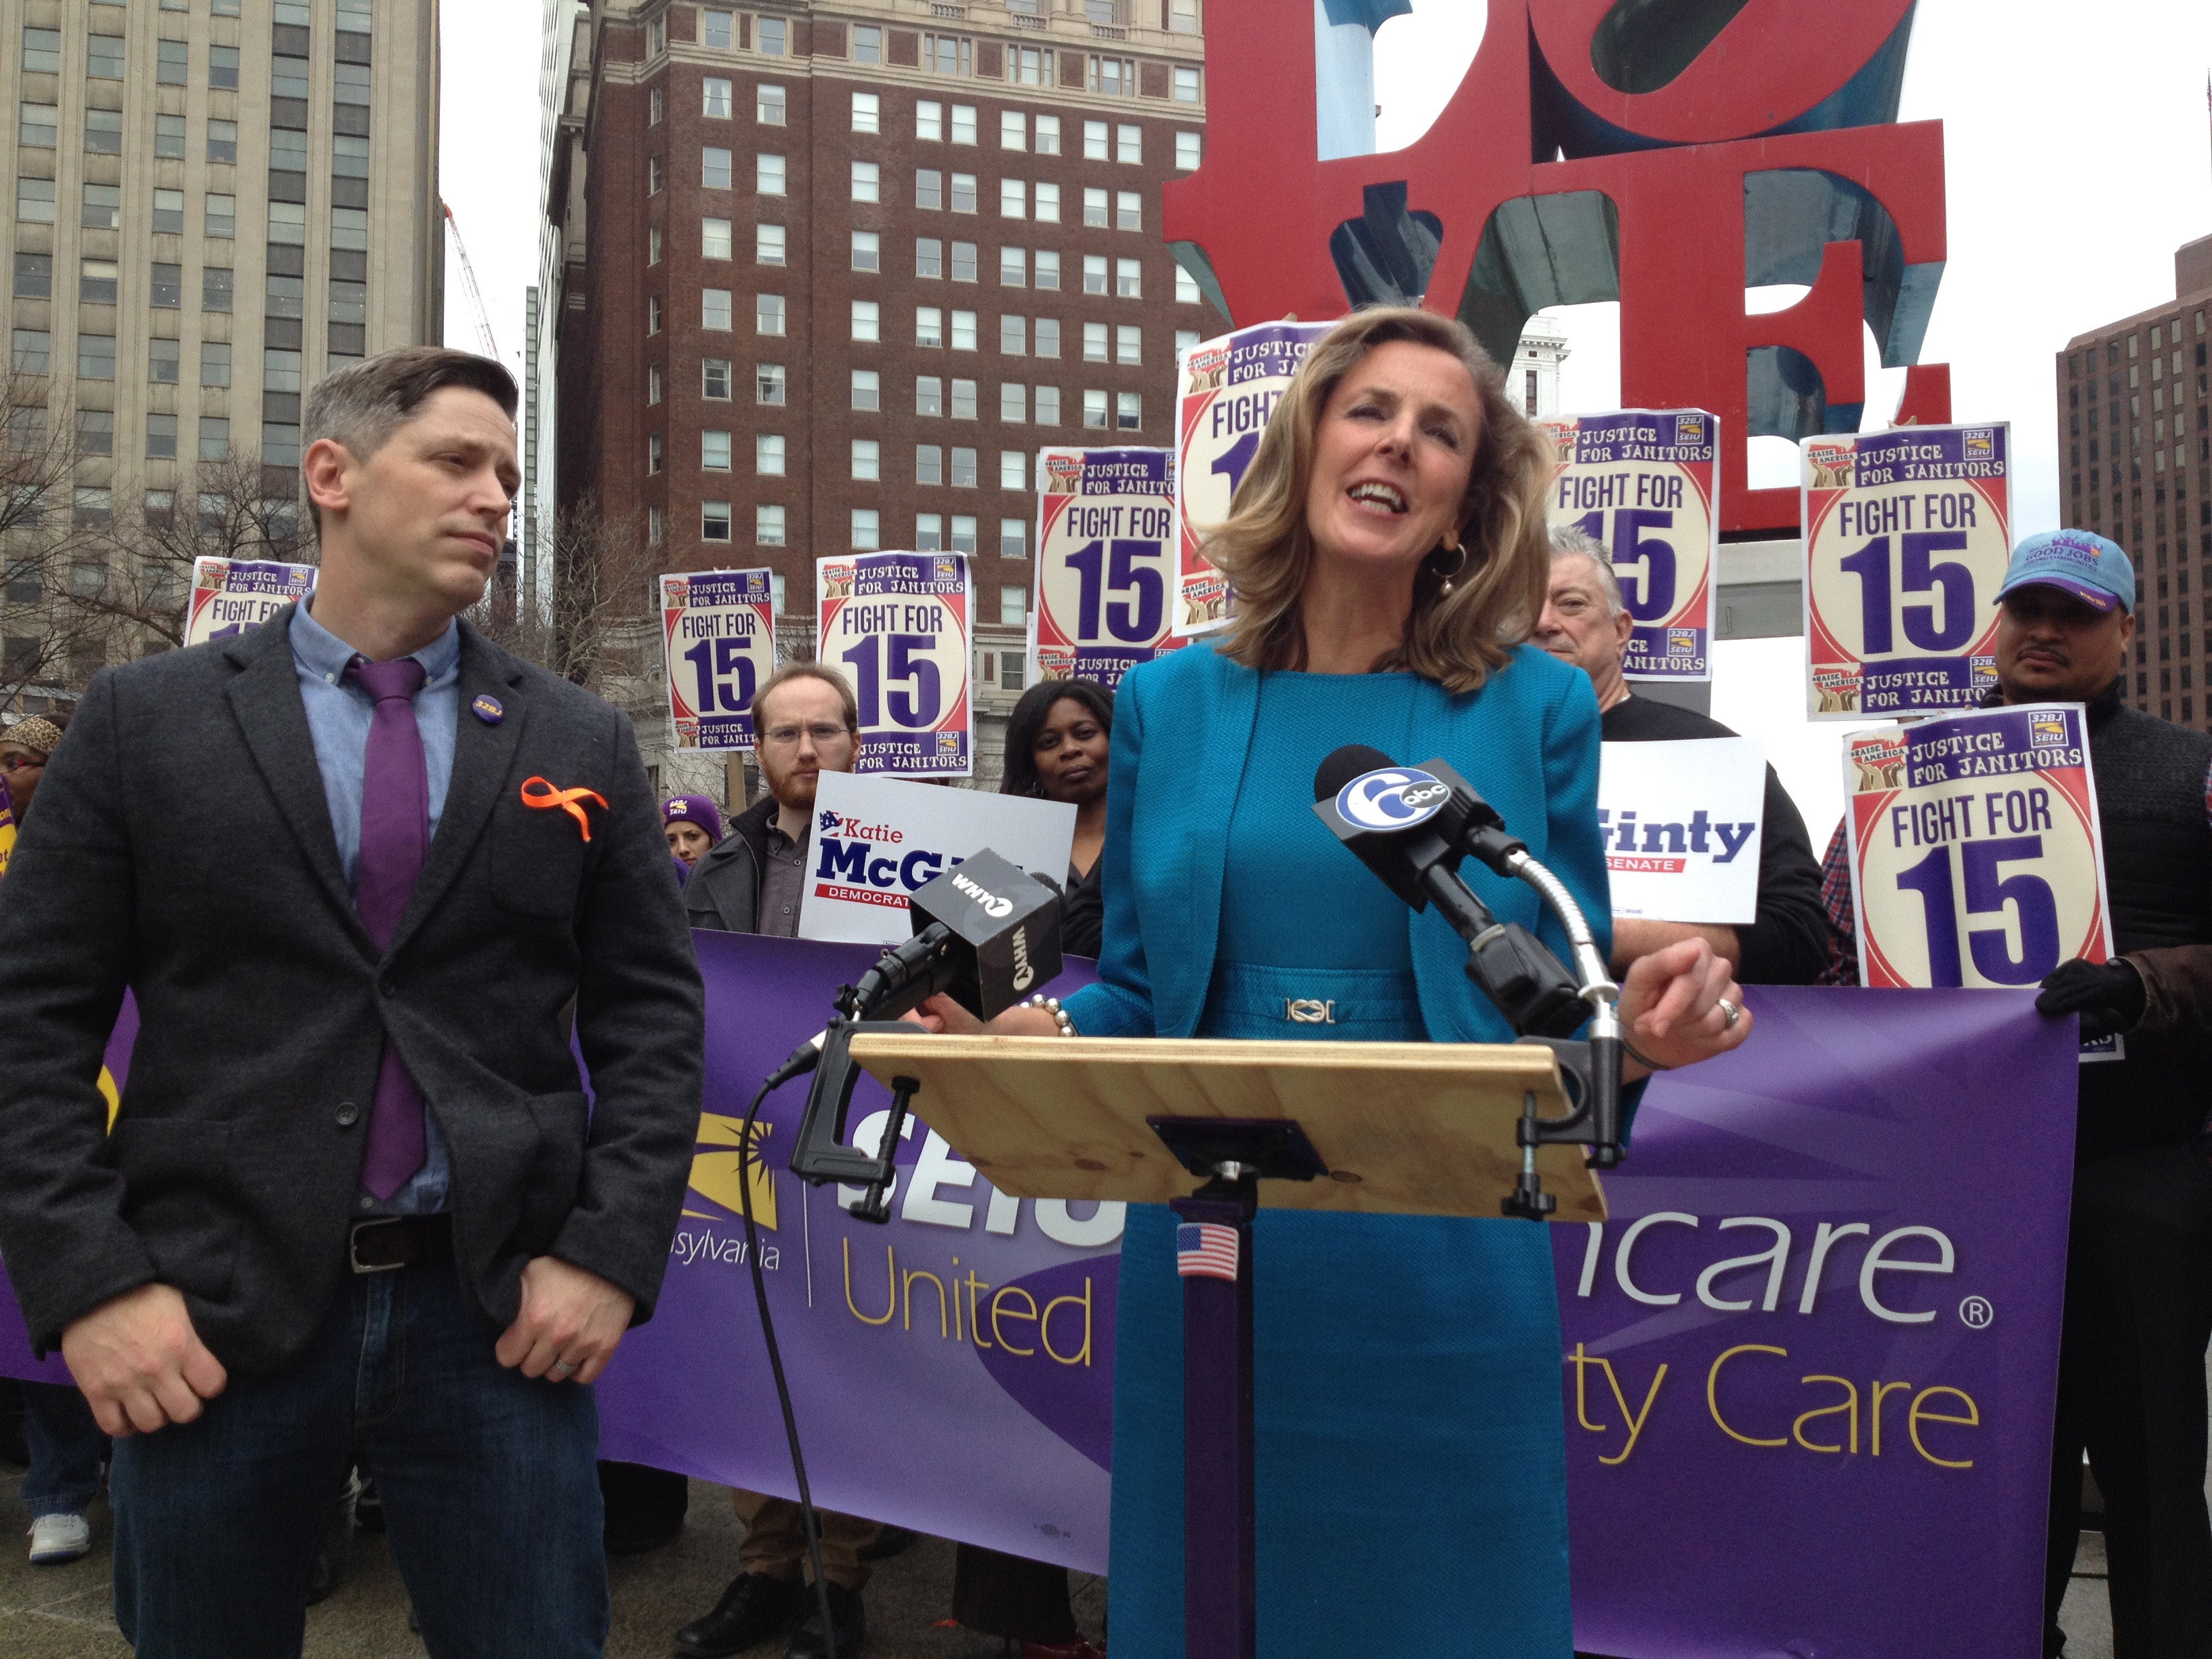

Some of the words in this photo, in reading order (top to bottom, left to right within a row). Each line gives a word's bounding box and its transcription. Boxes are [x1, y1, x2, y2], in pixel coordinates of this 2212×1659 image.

[1195, 354, 1227, 368] AMERICA
[1233, 363, 1267, 383] FOR
[1582, 428, 1656, 444] JUSTICE
[1965, 431, 1990, 439] 32BJ
[1581, 448, 1612, 462] FOR
[1622, 445, 1713, 460] JANITORS
[1820, 454, 1853, 463] AMERICA
[1861, 445, 1943, 467] JUSTICE
[1967, 448, 1990, 456] SEIU
[1087, 464, 1149, 478] JUSTICE
[1861, 468, 1894, 485] FOR
[1905, 461, 2004, 478] JANITORS
[1086, 482, 1111, 494] FOR
[1559, 474, 1630, 509] FIGHT
[1637, 474, 1683, 508] FOR
[1067, 506, 1124, 537] FIGHT
[1129, 507, 1171, 538] FOR
[1841, 495, 1916, 537] FIGHT
[1925, 493, 1976, 529] FOR
[1572, 509, 1676, 621] 5
[2066, 549, 2098, 566] JOBS
[230, 571, 277, 581] JUSTICE
[859, 565, 918, 580] JUSTICE
[229, 583, 248, 592] FOR
[252, 582, 312, 595] JANITORS
[692, 583, 736, 594] JUSTICE
[858, 582, 883, 594] FOR
[890, 580, 964, 594] JANITORS
[1065, 539, 1164, 642] 15
[1185, 582, 1206, 592] RAISE
[1193, 583, 1225, 598] AMERICA
[1840, 531, 1975, 655] 15
[693, 596, 711, 607] FOR
[715, 592, 769, 605] JANITORS
[212, 598, 255, 621] FIGHT
[259, 600, 285, 621] FO
[682, 613, 721, 638] FIGHT
[726, 613, 756, 636] FOR
[843, 605, 899, 635] FIGHT
[905, 605, 943, 634] FOR
[684, 636, 756, 712] 15
[842, 634, 941, 728] 15
[1824, 678, 1860, 687] AMERICA
[1866, 672, 1950, 689] JUSTICE
[1866, 692, 1901, 707] FOR
[2032, 714, 2062, 722] 32BJ
[701, 724, 743, 734] JUSTICE
[2034, 733, 2064, 742] SEIU
[702, 735, 720, 745] FOR
[1912, 733, 2005, 762] JUSTICE
[861, 743, 921, 756] JUSTICE
[1855, 745, 1881, 756] RAISE
[1864, 748, 1904, 762] AMERICA
[859, 757, 884, 769] FOR
[893, 756, 966, 769] JANITORS
[1914, 762, 1948, 785] FOR
[1959, 749, 2082, 776] JANITORS
[1403, 784, 1446, 805] abc
[1891, 794, 1975, 848] FIGHT
[1985, 787, 2052, 836] FOR
[844, 818, 903, 843] Katie
[828, 888, 909, 907] DEMOCRAT
[1896, 834, 2060, 987] 15
[842, 1237, 1091, 1368] United
[1706, 1344, 1980, 1469] Care
